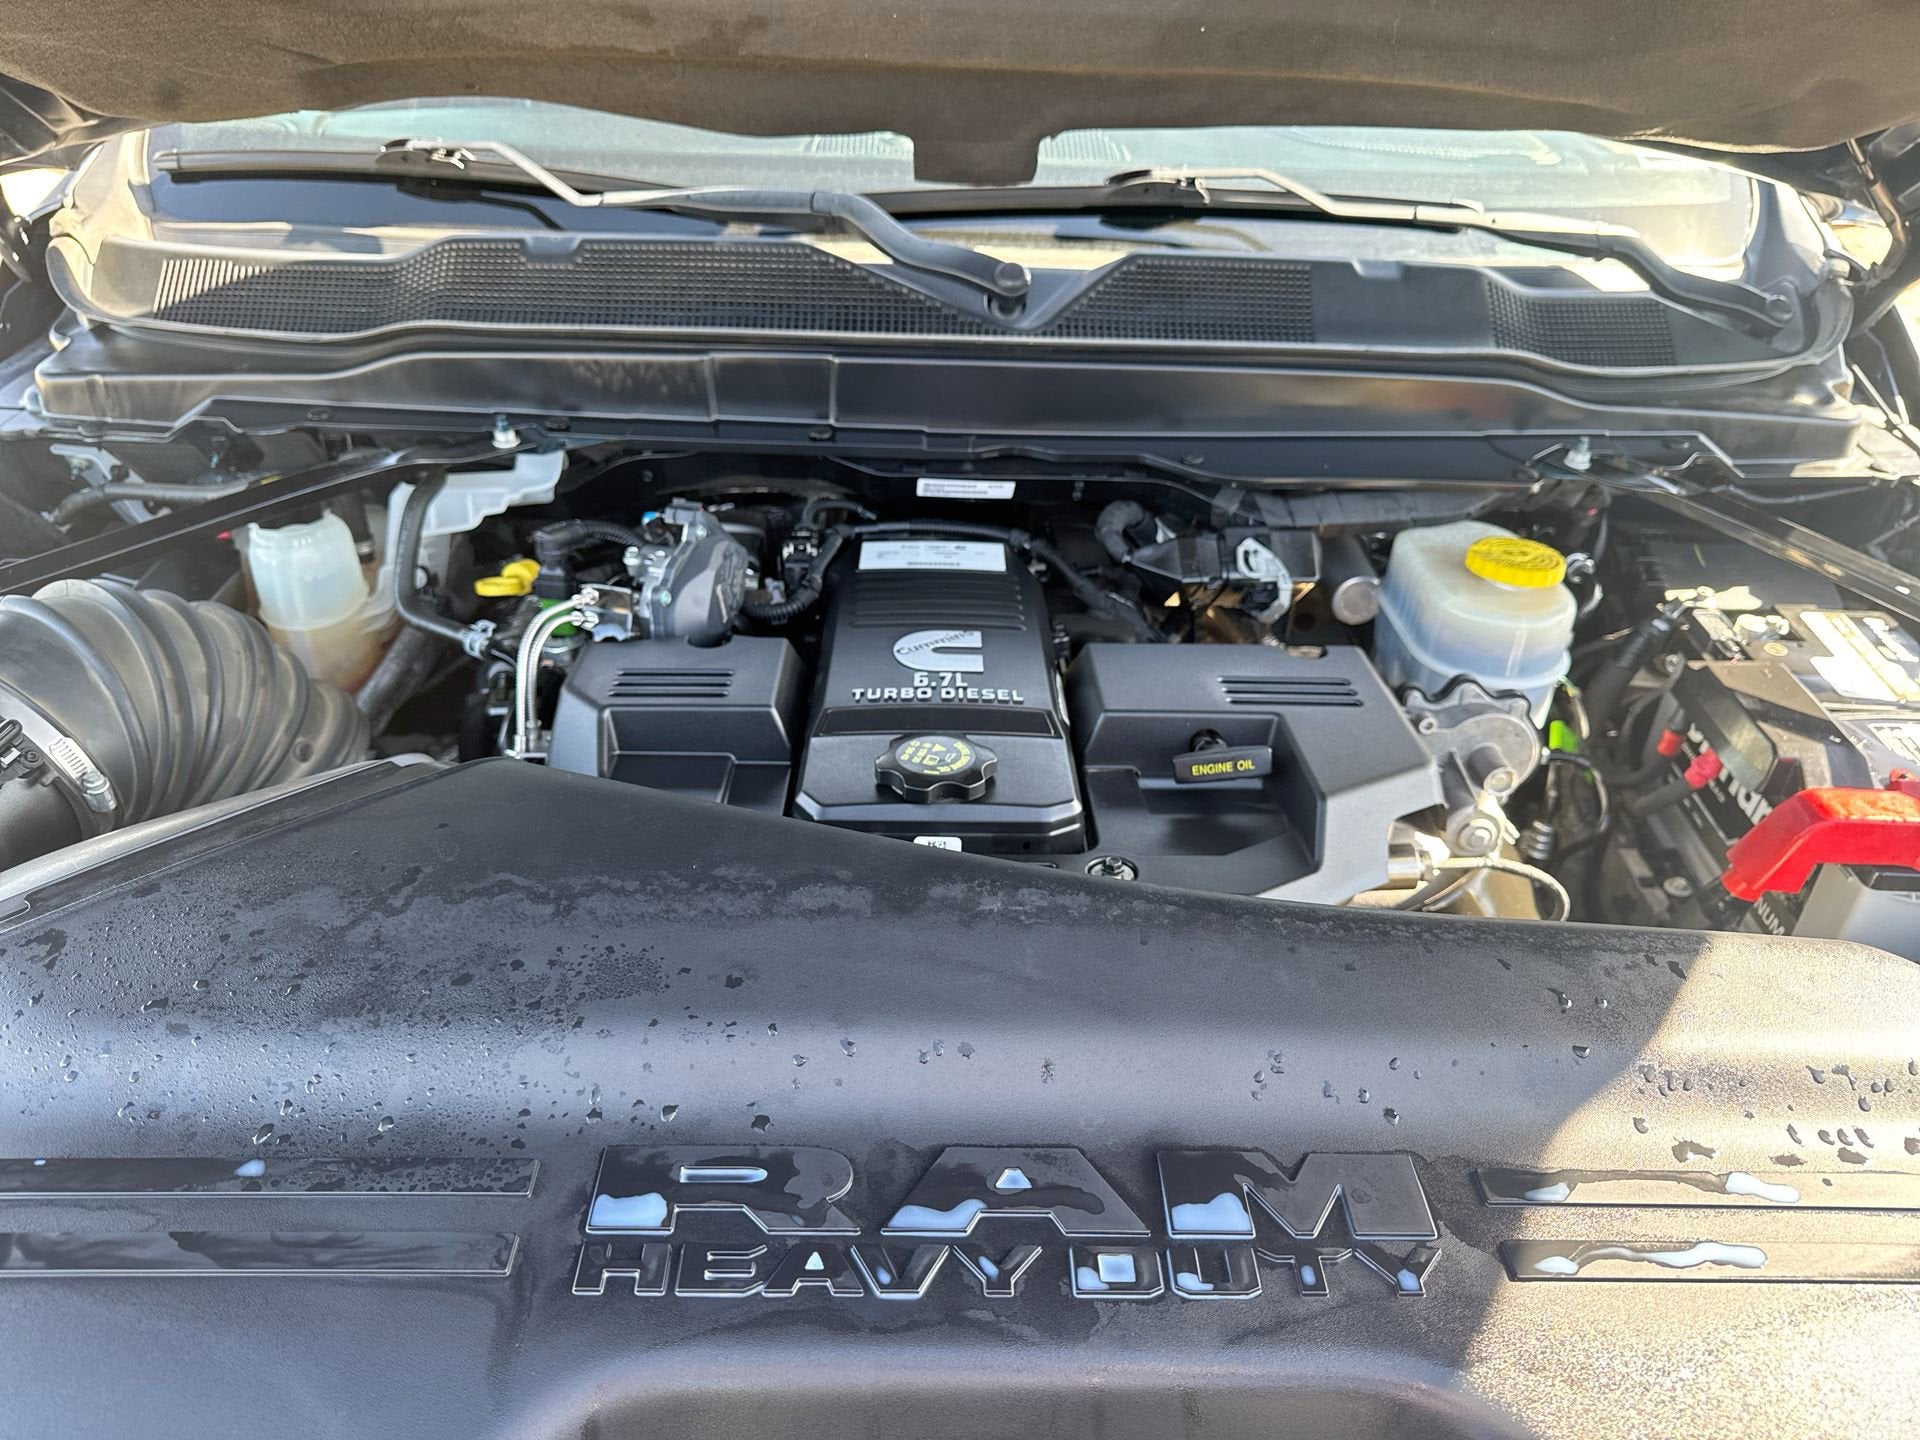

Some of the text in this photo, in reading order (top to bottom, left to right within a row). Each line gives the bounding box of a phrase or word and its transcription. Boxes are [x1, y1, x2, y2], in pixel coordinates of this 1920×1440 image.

[896, 630, 975, 656] Cummins
[913, 672, 968, 687] 6.7L
[852, 687, 1025, 702] TURBO DIESEL
[1191, 759, 1255, 776] ENGINE OIL
[586, 1145, 1438, 1239] RAM
[572, 1242, 1443, 1299] HEAVY DUTY
